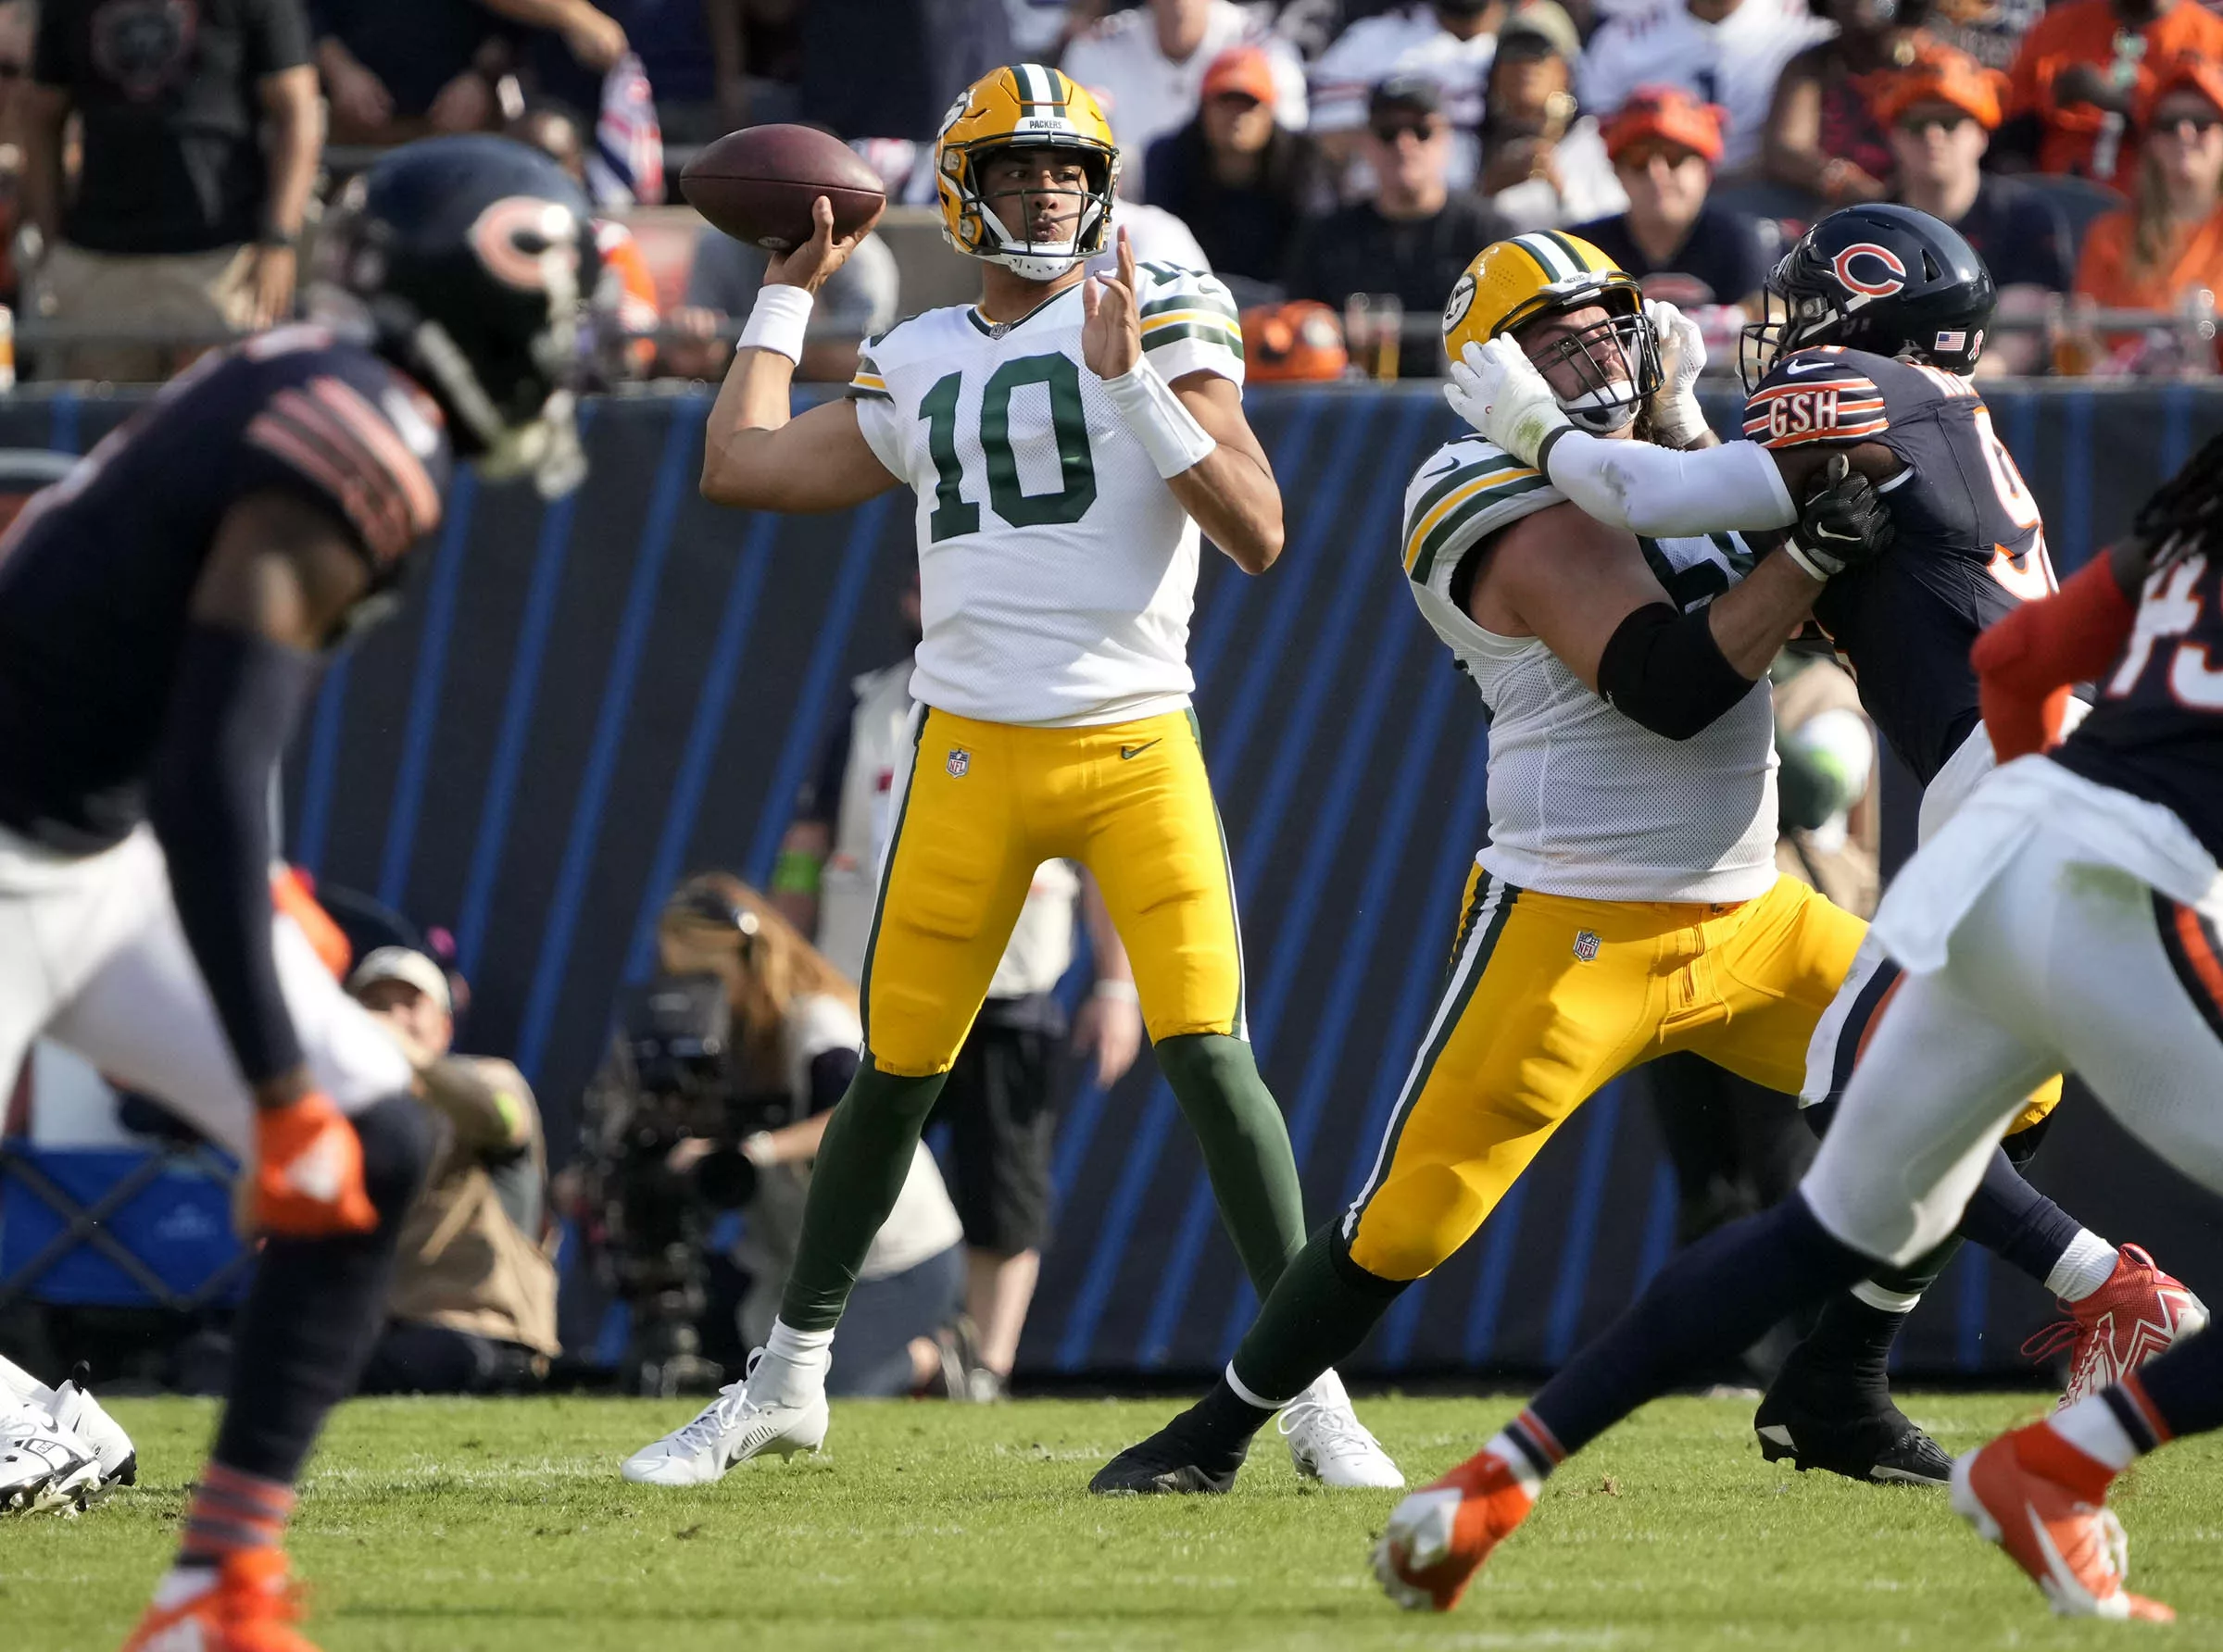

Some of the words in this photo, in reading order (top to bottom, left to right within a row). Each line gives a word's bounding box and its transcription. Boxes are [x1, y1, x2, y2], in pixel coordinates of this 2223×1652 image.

[1029, 119, 1062, 130] PACKERS
[1830, 243, 1907, 298] C
[1768, 389, 1840, 439] GSH
[918, 351, 1098, 544] 10
[1578, 943, 1593, 957] NFL
